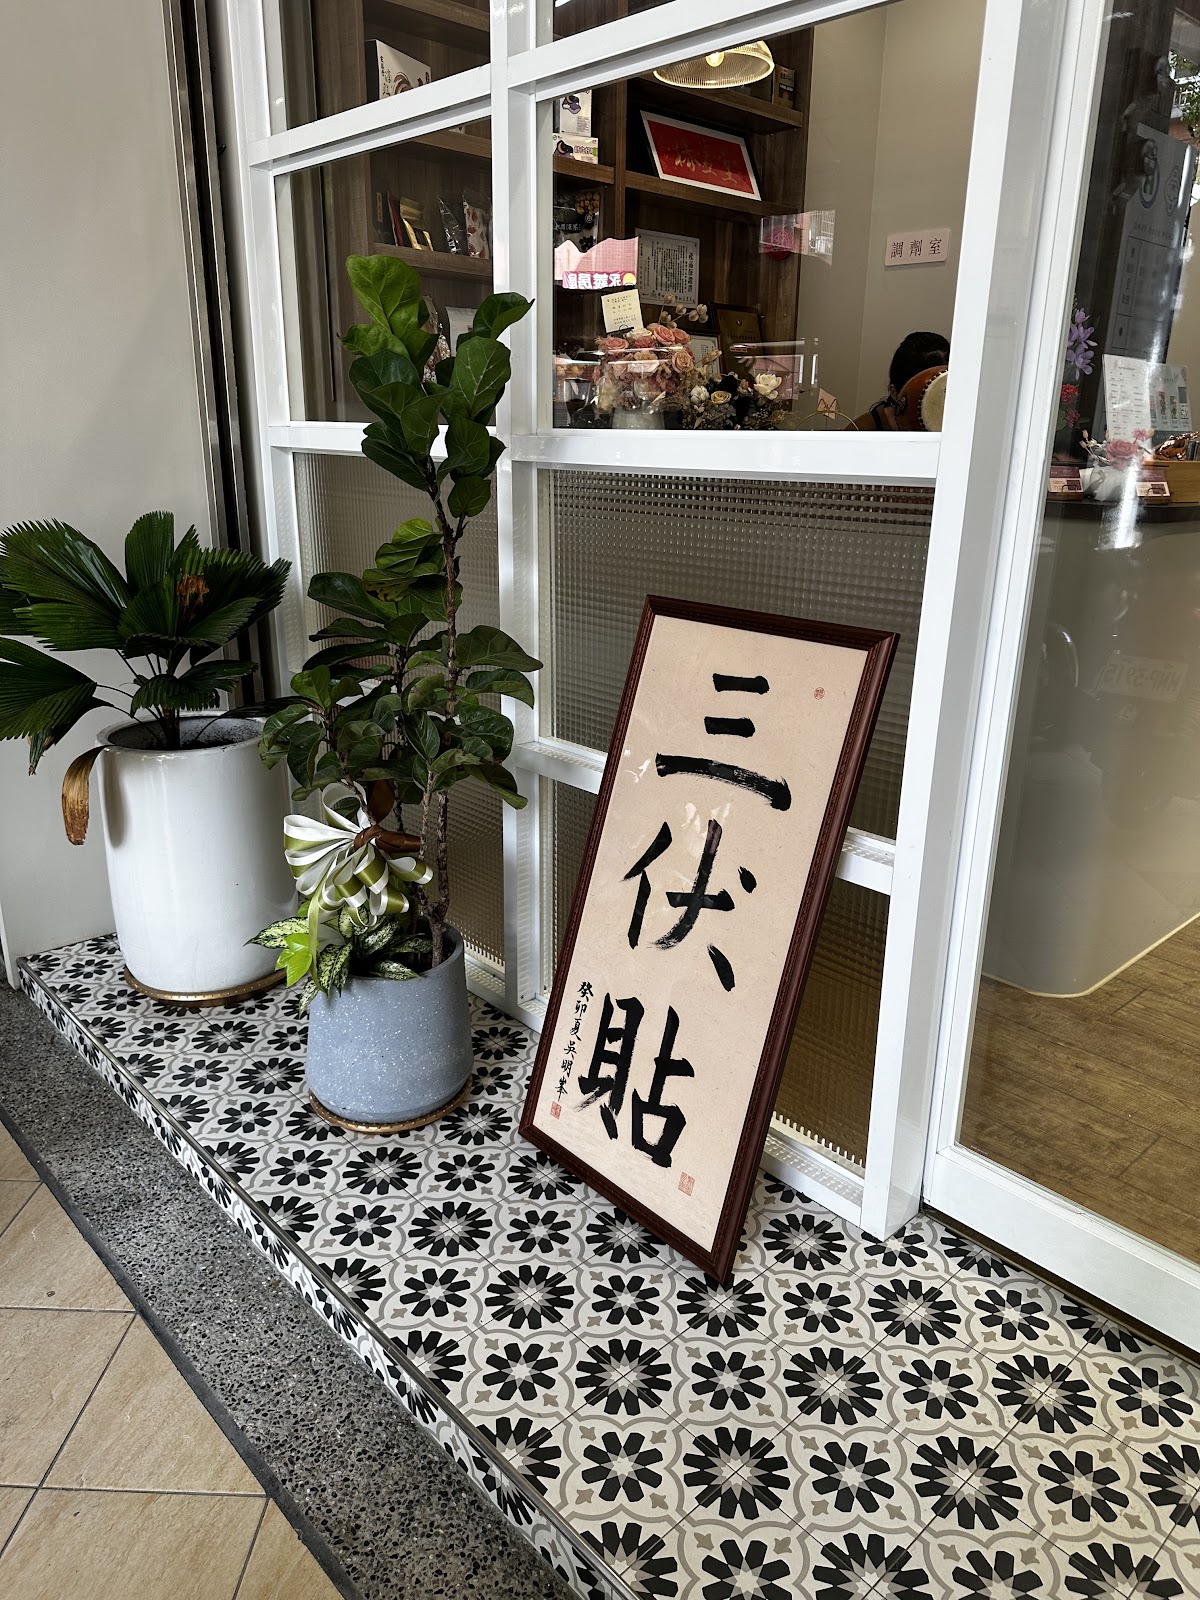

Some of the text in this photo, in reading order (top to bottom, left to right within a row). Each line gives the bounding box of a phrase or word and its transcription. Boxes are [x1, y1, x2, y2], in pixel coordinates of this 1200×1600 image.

[890, 237, 942, 259] 調劑室
[578, 673, 792, 1168] 三伏貼
